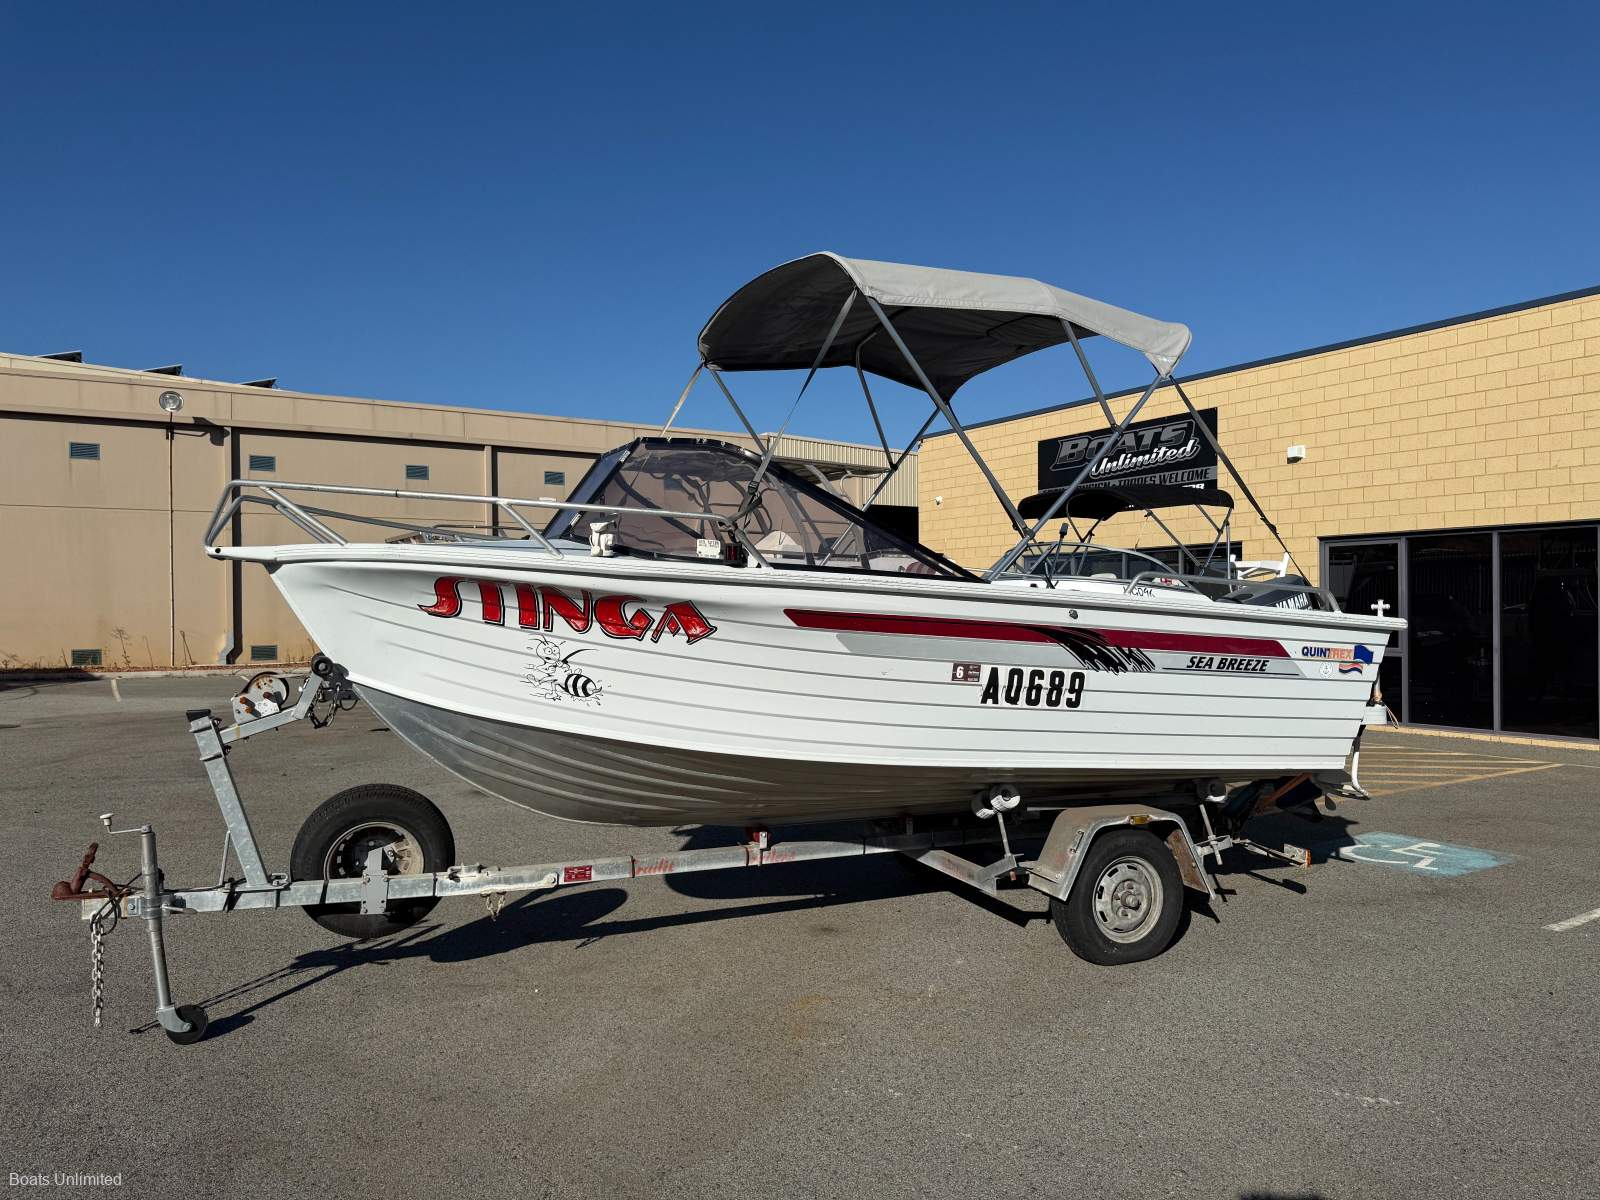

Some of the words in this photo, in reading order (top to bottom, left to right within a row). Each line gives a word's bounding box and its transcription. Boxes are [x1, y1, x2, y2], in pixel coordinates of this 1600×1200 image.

[1057, 423, 1188, 462] BOATS
[1091, 439, 1197, 475] Unlimited
[1158, 468, 1210, 485] WELCOME
[416, 576, 718, 645] STINGA
[1301, 645, 1353, 660] QUINTREX
[956, 665, 964, 679] 6
[1186, 655, 1213, 670] SEA
[1216, 656, 1270, 673] BREEZE
